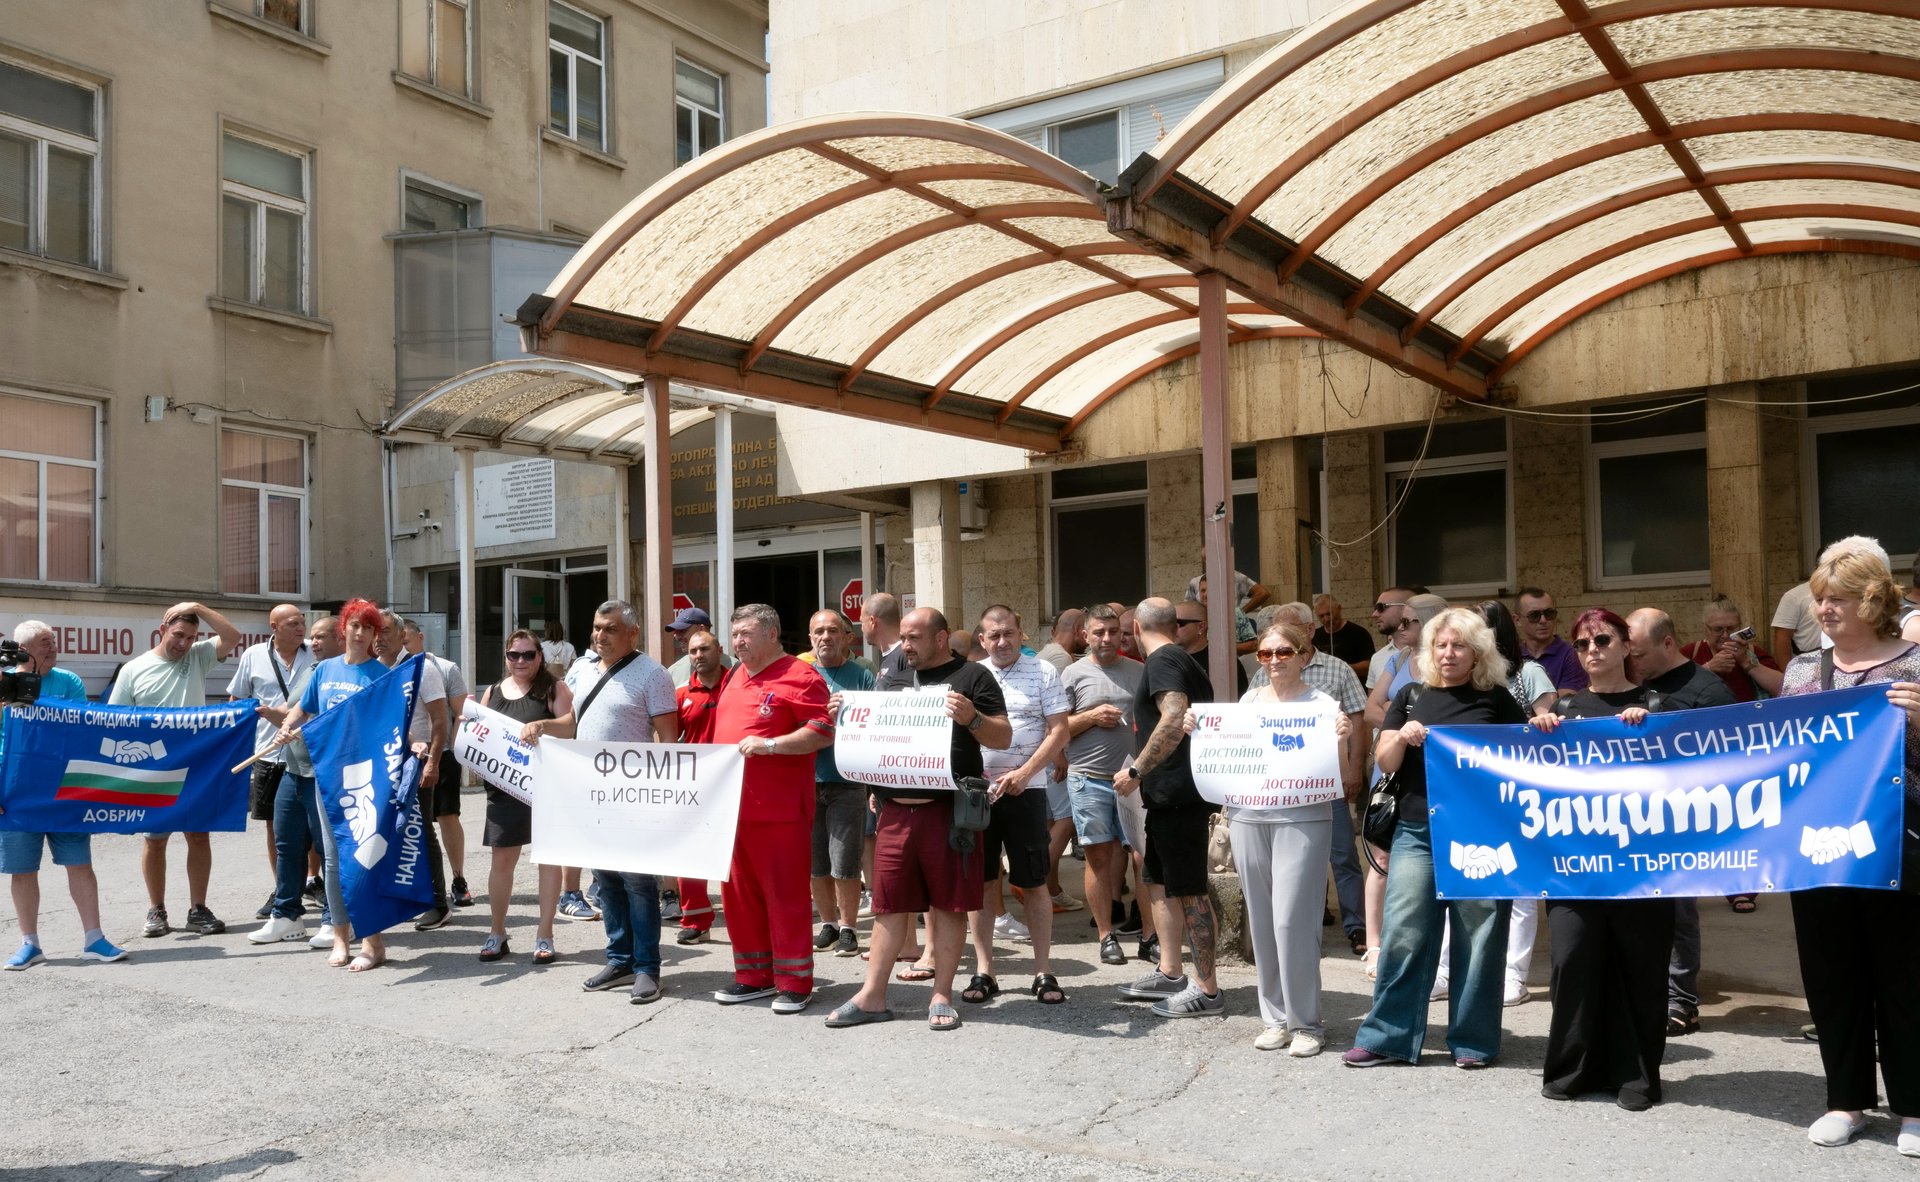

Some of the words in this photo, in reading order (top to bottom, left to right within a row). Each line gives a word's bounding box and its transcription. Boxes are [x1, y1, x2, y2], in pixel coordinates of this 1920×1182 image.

[671, 440, 762, 463] ОГОПРОИЛНА
[689, 460, 747, 476] АКТНО
[751, 454, 777, 469] ЛЕЧ
[705, 477, 751, 492] ШЕН
[755, 473, 774, 487] АД
[674, 502, 717, 516] СПЕШН
[734, 494, 800, 510] ОТДЕЛЕ
[846, 595, 864, 609] STO
[52, 626, 133, 656] ПЕШНО
[880, 694, 945, 708] ДОСТОЙНО
[10, 704, 80, 724] НАЦИОНАЛЕН
[84, 710, 141, 728] СИНДИКАТ
[145, 709, 242, 735] "ЗАЩИТА"
[849, 707, 871, 723] 112
[1205, 716, 1222, 729] 112
[869, 734, 913, 743] ТЪРГОВИЩЕ
[1456, 735, 1667, 769] НАЦИОНАЛЕН
[1673, 711, 1860, 757] СИНДИКАТ
[878, 753, 945, 769] ДОСТОЙНИ
[1199, 745, 1263, 759] ДОСТОЙНО
[463, 745, 534, 795] ПРОТЕС
[594, 748, 697, 781] ФСМП
[844, 771, 898, 785] УСЛОВИЯ
[900, 774, 917, 785] НА
[919, 775, 951, 788] ТРУД
[1261, 776, 1335, 791] ДОСТОЙНИ
[1224, 794, 1279, 806] УСЛОВИЯ
[1282, 795, 1300, 806] НА
[1304, 791, 1337, 804] ТРУД
[82, 808, 146, 823] ДОБРИЧ
[394, 794, 424, 885] НАЦИОНА
[1553, 854, 1613, 876] ЦСМП
[1628, 849, 1759, 872] ТЪРГОВИЩЕ
